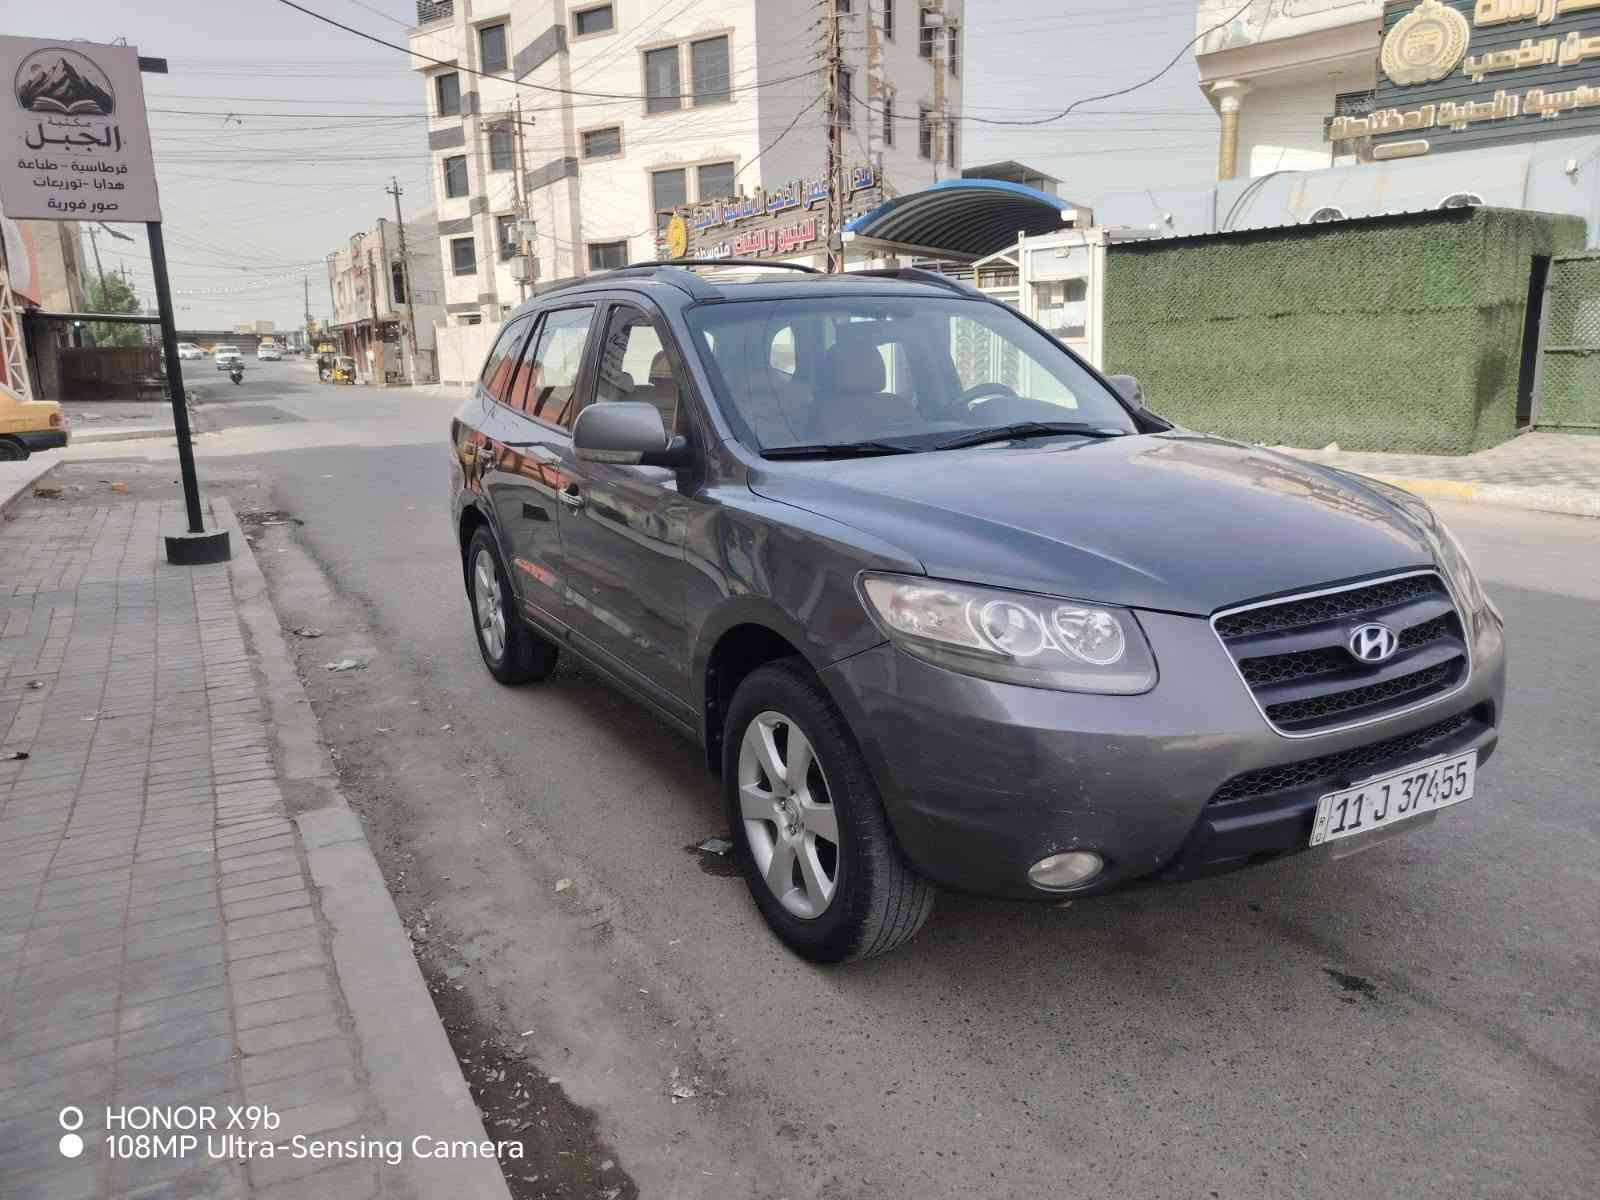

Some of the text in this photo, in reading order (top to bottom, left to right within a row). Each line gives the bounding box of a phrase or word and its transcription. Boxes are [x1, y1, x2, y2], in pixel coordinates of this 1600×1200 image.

[48, 116, 92, 128] مكتبة
[25, 123, 122, 152] الجبل
[18, 158, 58, 171] طباعة
[71, 161, 128, 174] قرطاسية
[93, 178, 125, 190] هدايا
[48, 198, 119, 212] صور فورية
[1331, 793, 1365, 834] 11
[1374, 785, 1391, 821] J
[1398, 761, 1468, 814] 37455
